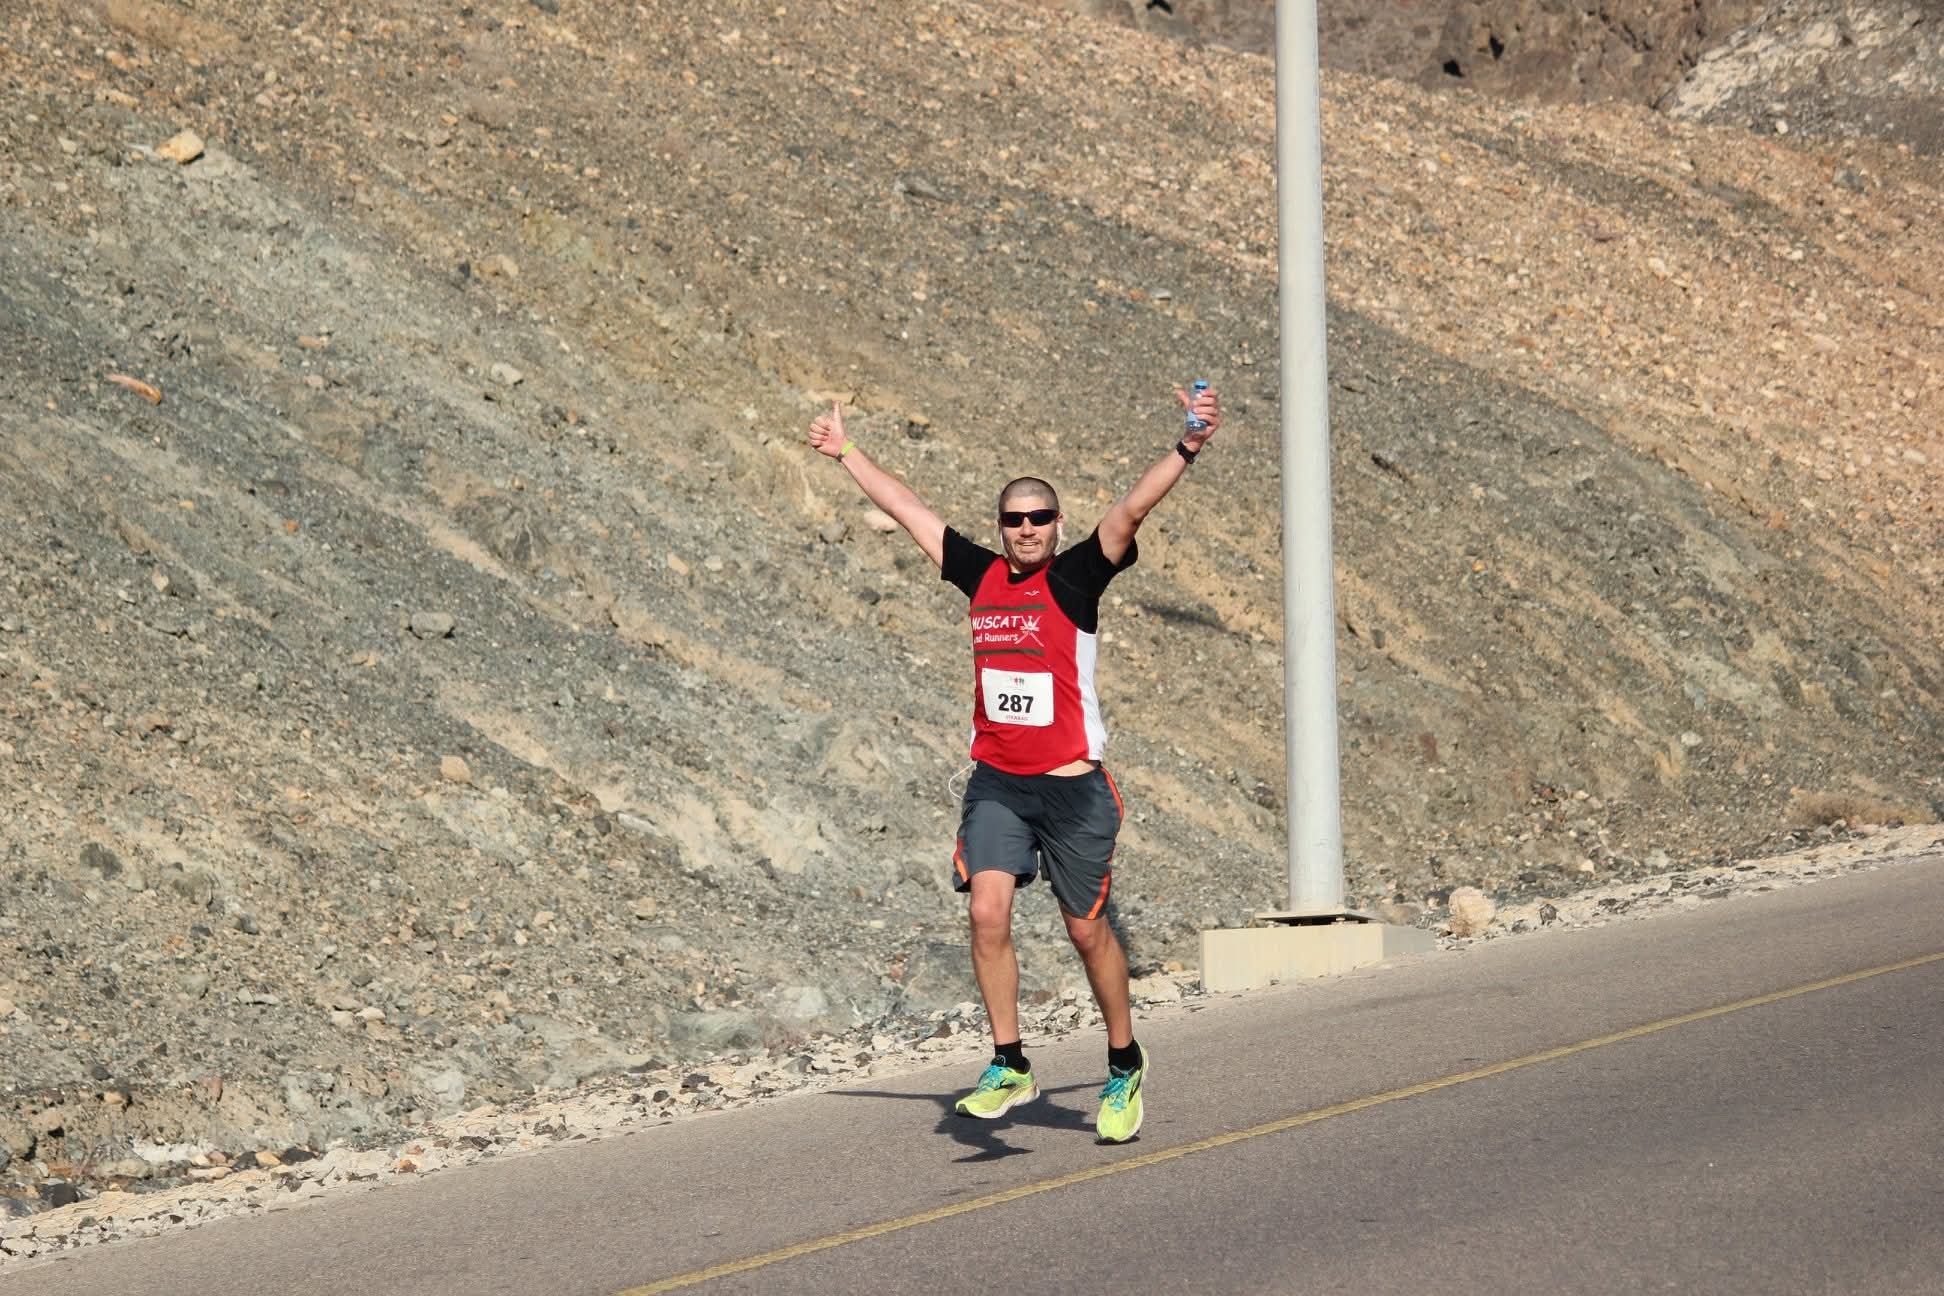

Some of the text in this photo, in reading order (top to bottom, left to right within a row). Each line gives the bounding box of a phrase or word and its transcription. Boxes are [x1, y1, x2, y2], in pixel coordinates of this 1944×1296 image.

[972, 615, 1021, 631] MUSCAT
[984, 632, 1019, 643] Runners
[998, 693, 1034, 713] 287
